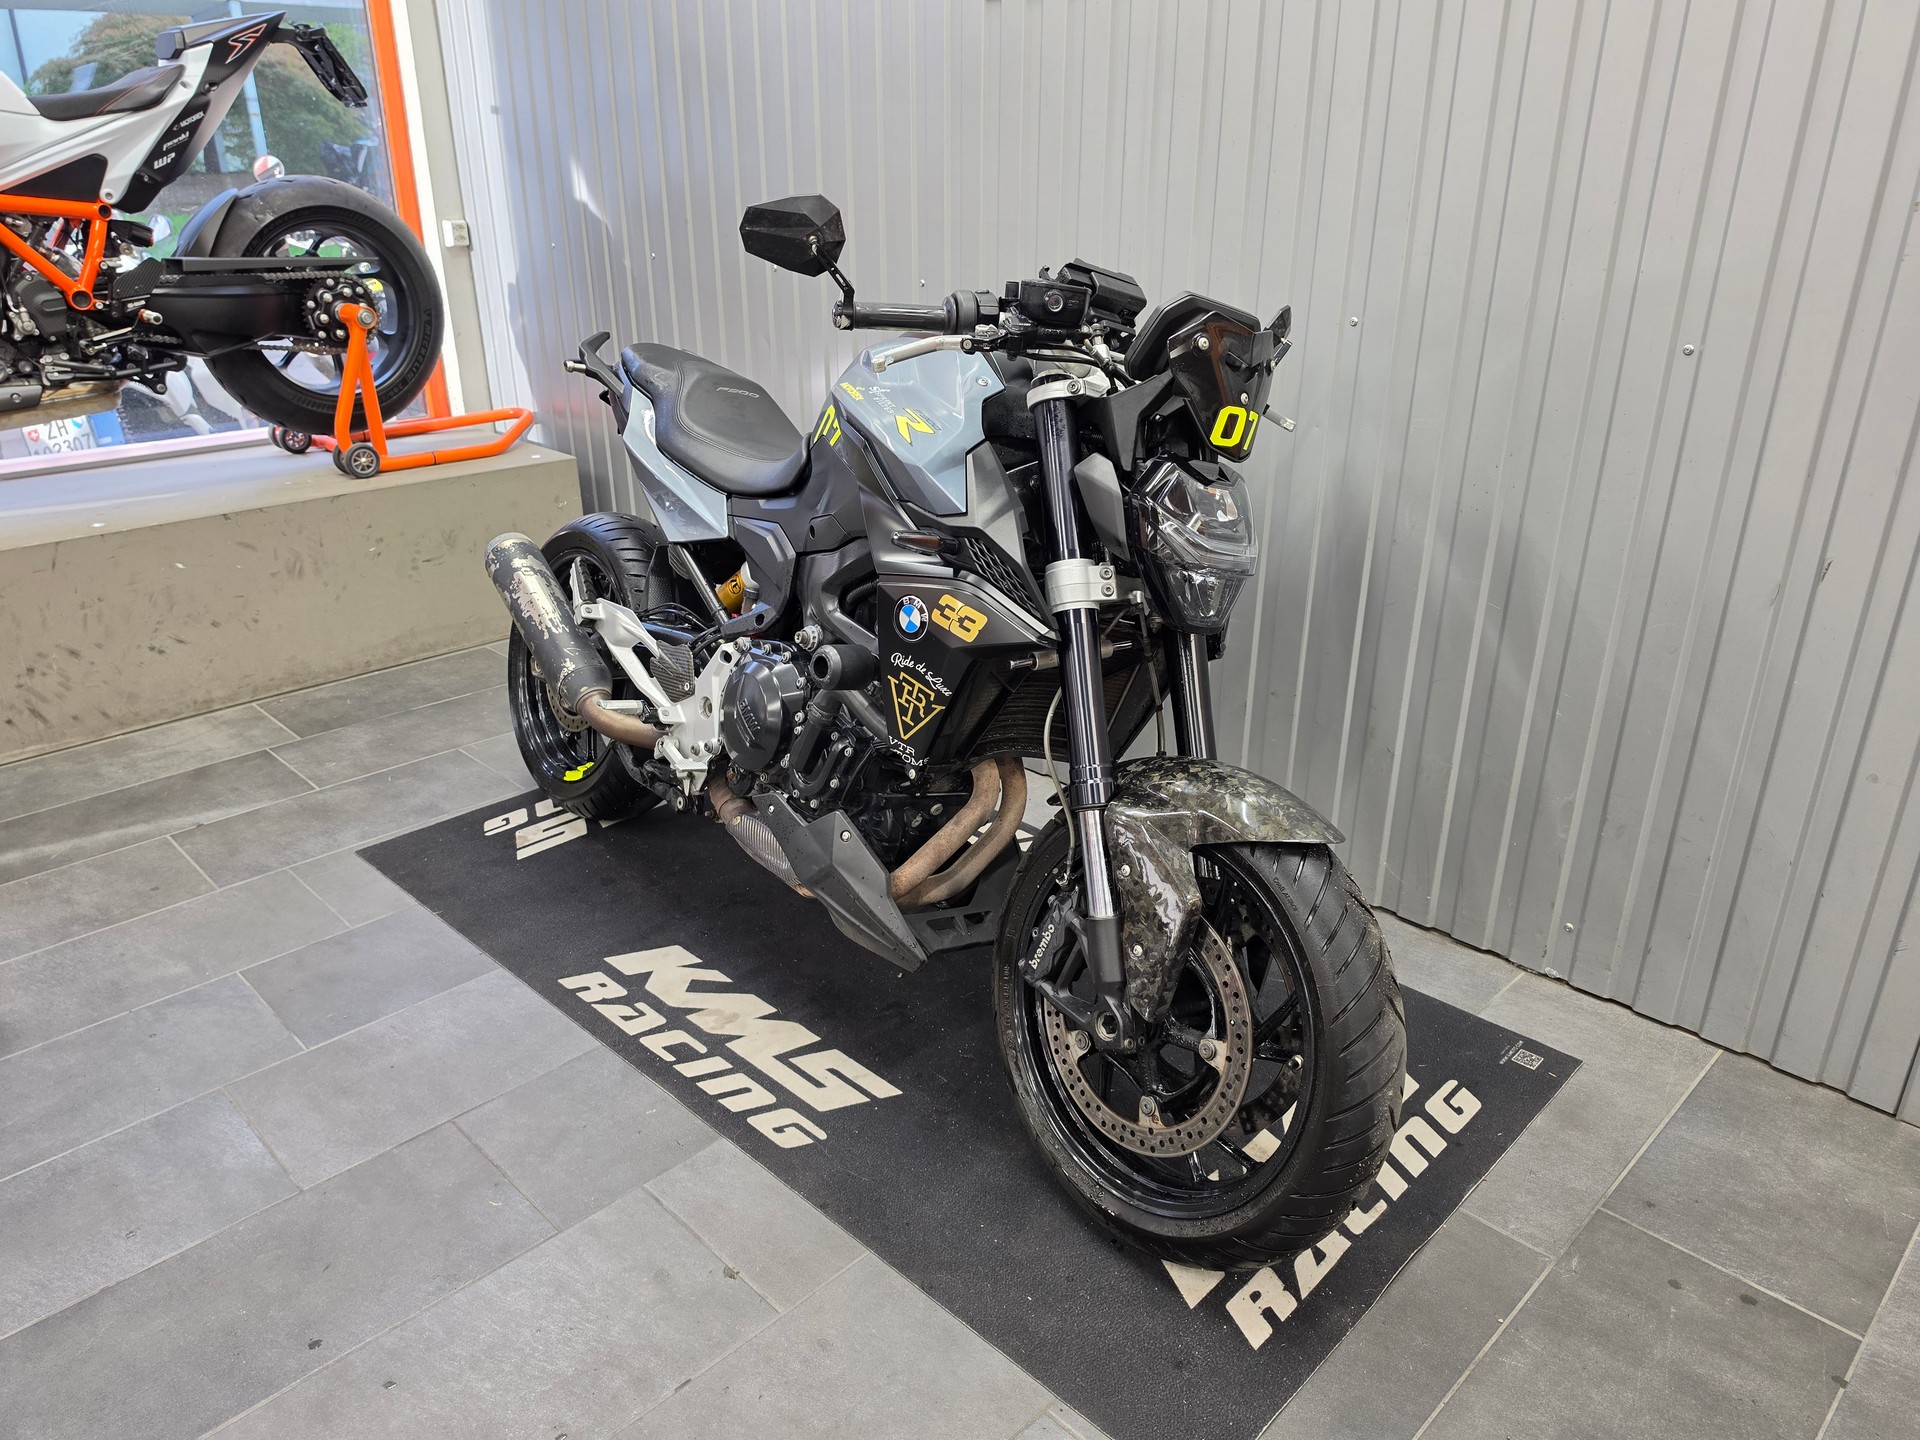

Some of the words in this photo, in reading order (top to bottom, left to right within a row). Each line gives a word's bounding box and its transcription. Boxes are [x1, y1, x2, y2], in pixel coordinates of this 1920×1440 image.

[153, 151, 176, 170] WP
[33, 432, 92, 456] 2307
[44, 418, 69, 441] ZH
[931, 593, 988, 643] 33
[890, 652, 915, 668] Ride
[915, 662, 927, 676] de
[925, 671, 953, 697] Luxe
[888, 734, 915, 757] VTR
[1028, 923, 1056, 970] brembo
[603, 944, 904, 1112] KMS
